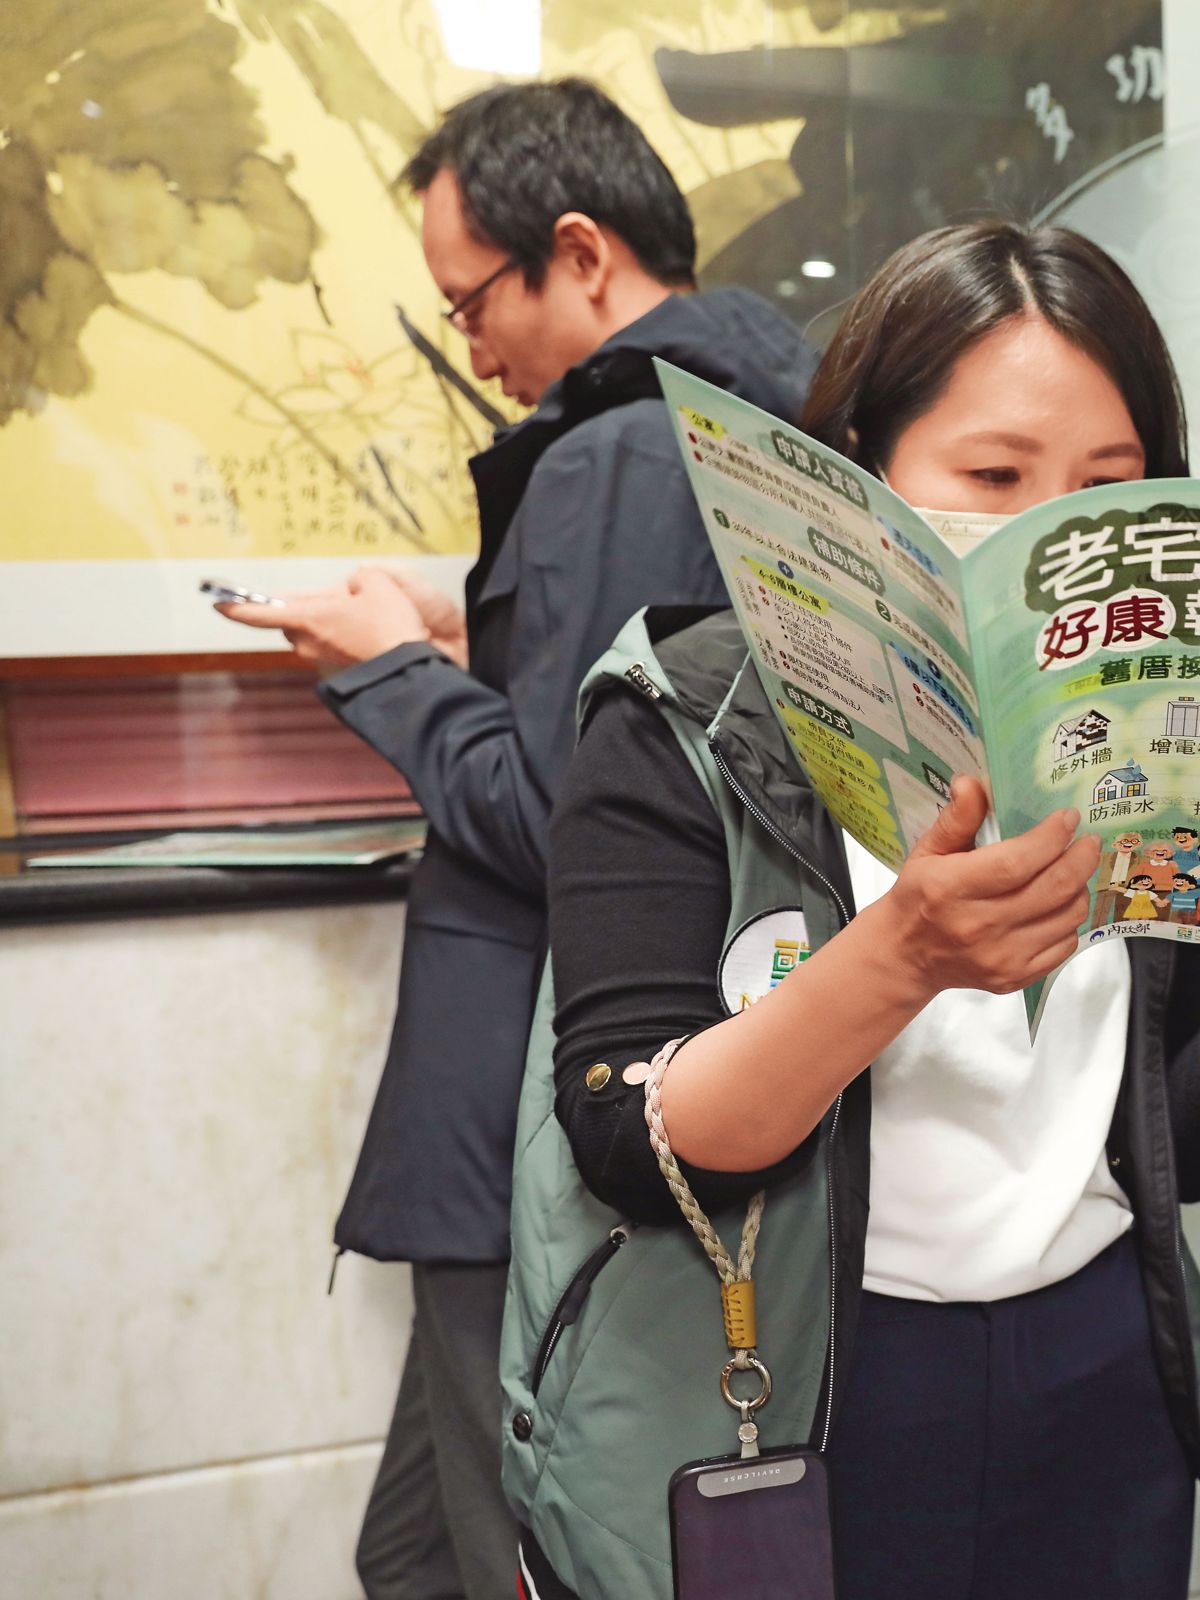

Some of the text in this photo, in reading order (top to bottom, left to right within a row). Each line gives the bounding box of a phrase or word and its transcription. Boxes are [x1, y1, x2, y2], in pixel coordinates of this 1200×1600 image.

[776, 436, 864, 504] 申請人資格
[812, 532, 881, 588] 補助條件
[787, 687, 851, 735] 申請方式
[1050, 746, 1113, 783] 修外牆
[1089, 799, 1156, 823] 防漏水
[1107, 922, 1151, 936] 內政部
